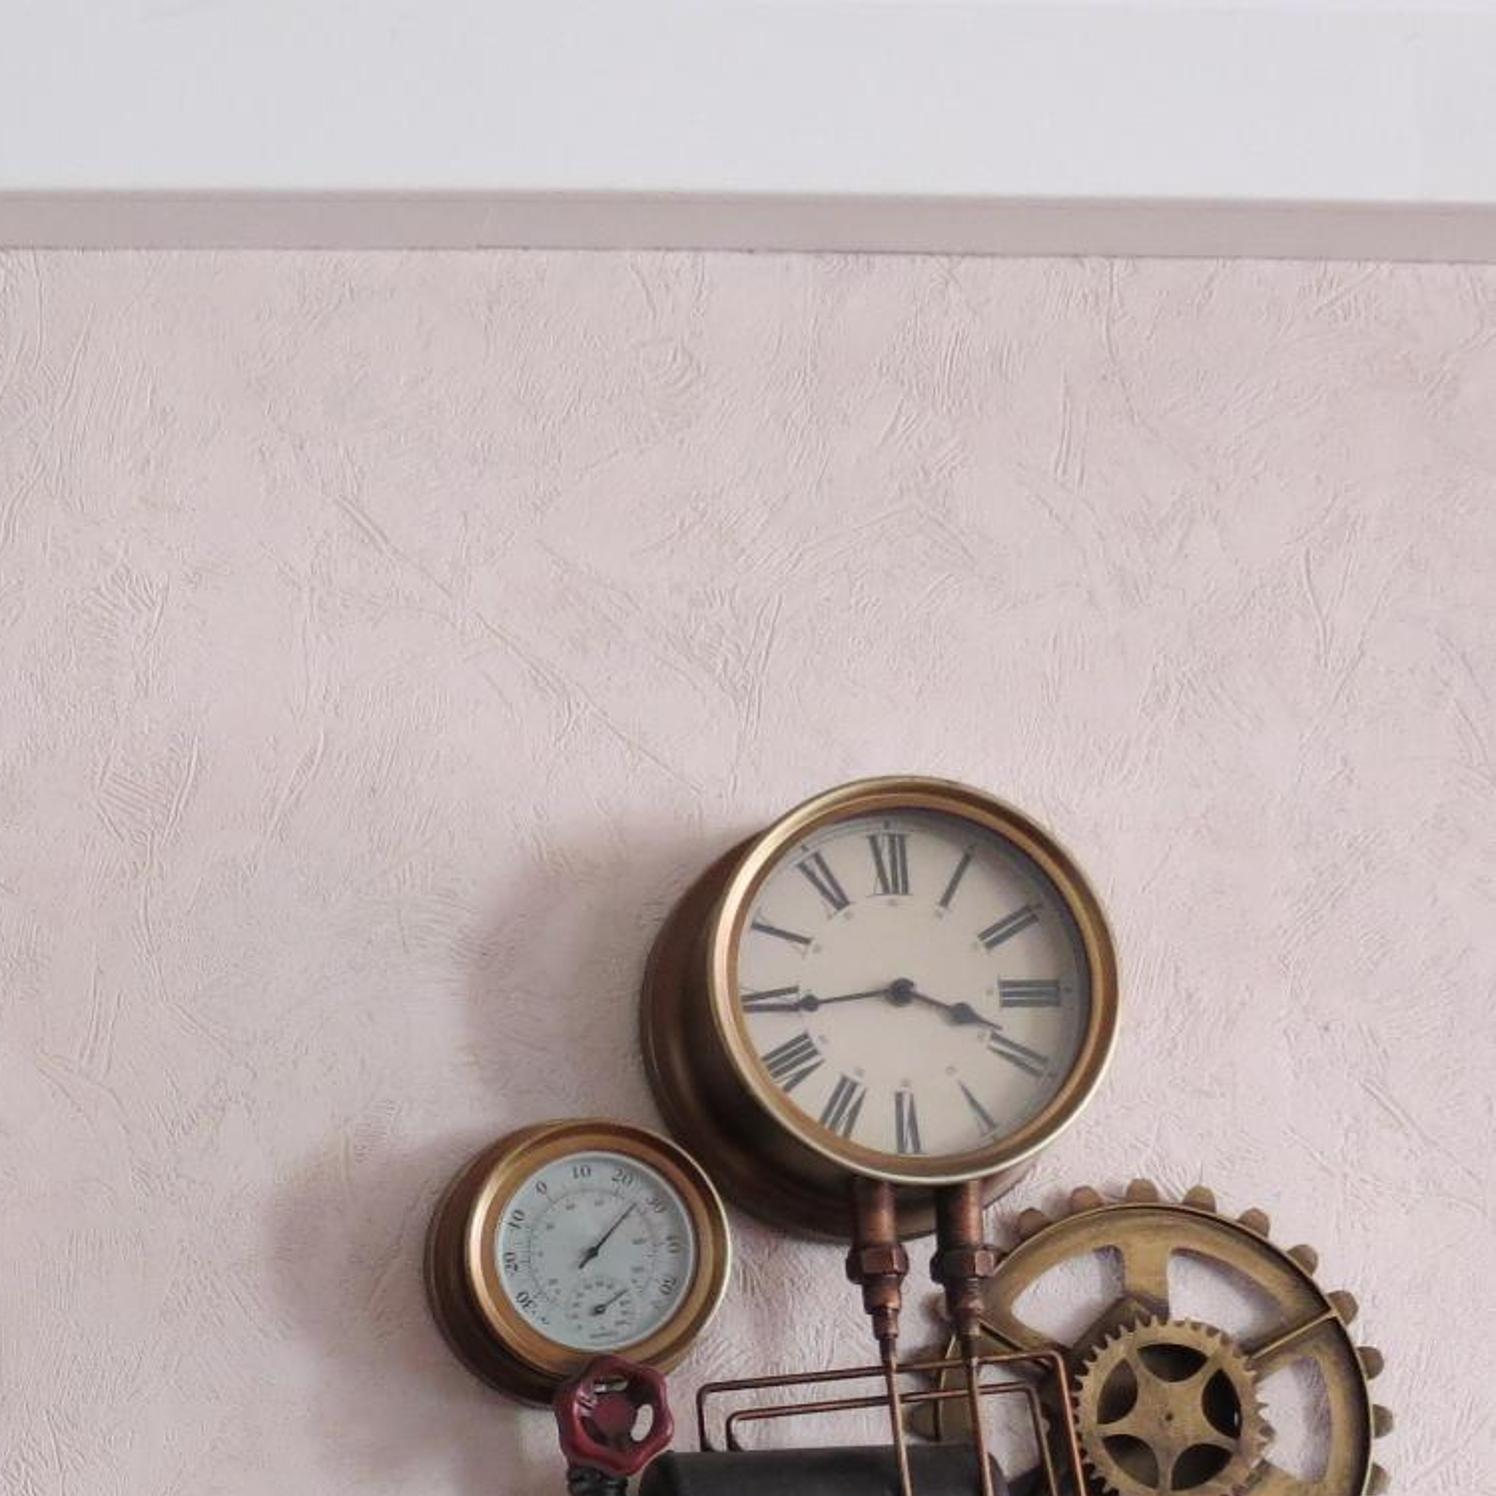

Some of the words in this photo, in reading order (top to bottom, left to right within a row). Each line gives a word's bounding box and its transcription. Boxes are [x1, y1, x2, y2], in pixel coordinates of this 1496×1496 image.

[866, 832, 913, 897] XII
[937, 849, 973, 910] I
[976, 901, 1040, 950] II
[996, 978, 1061, 1009] III
[761, 1031, 825, 1093] VIII
[819, 1074, 867, 1140] VII
[895, 1089, 923, 1155] VI
[535, 1180, 548, 1195] 0
[572, 1164, 592, 1180] 10
[611, 1167, 634, 1186] 20
[507, 1208, 526, 1230] 10
